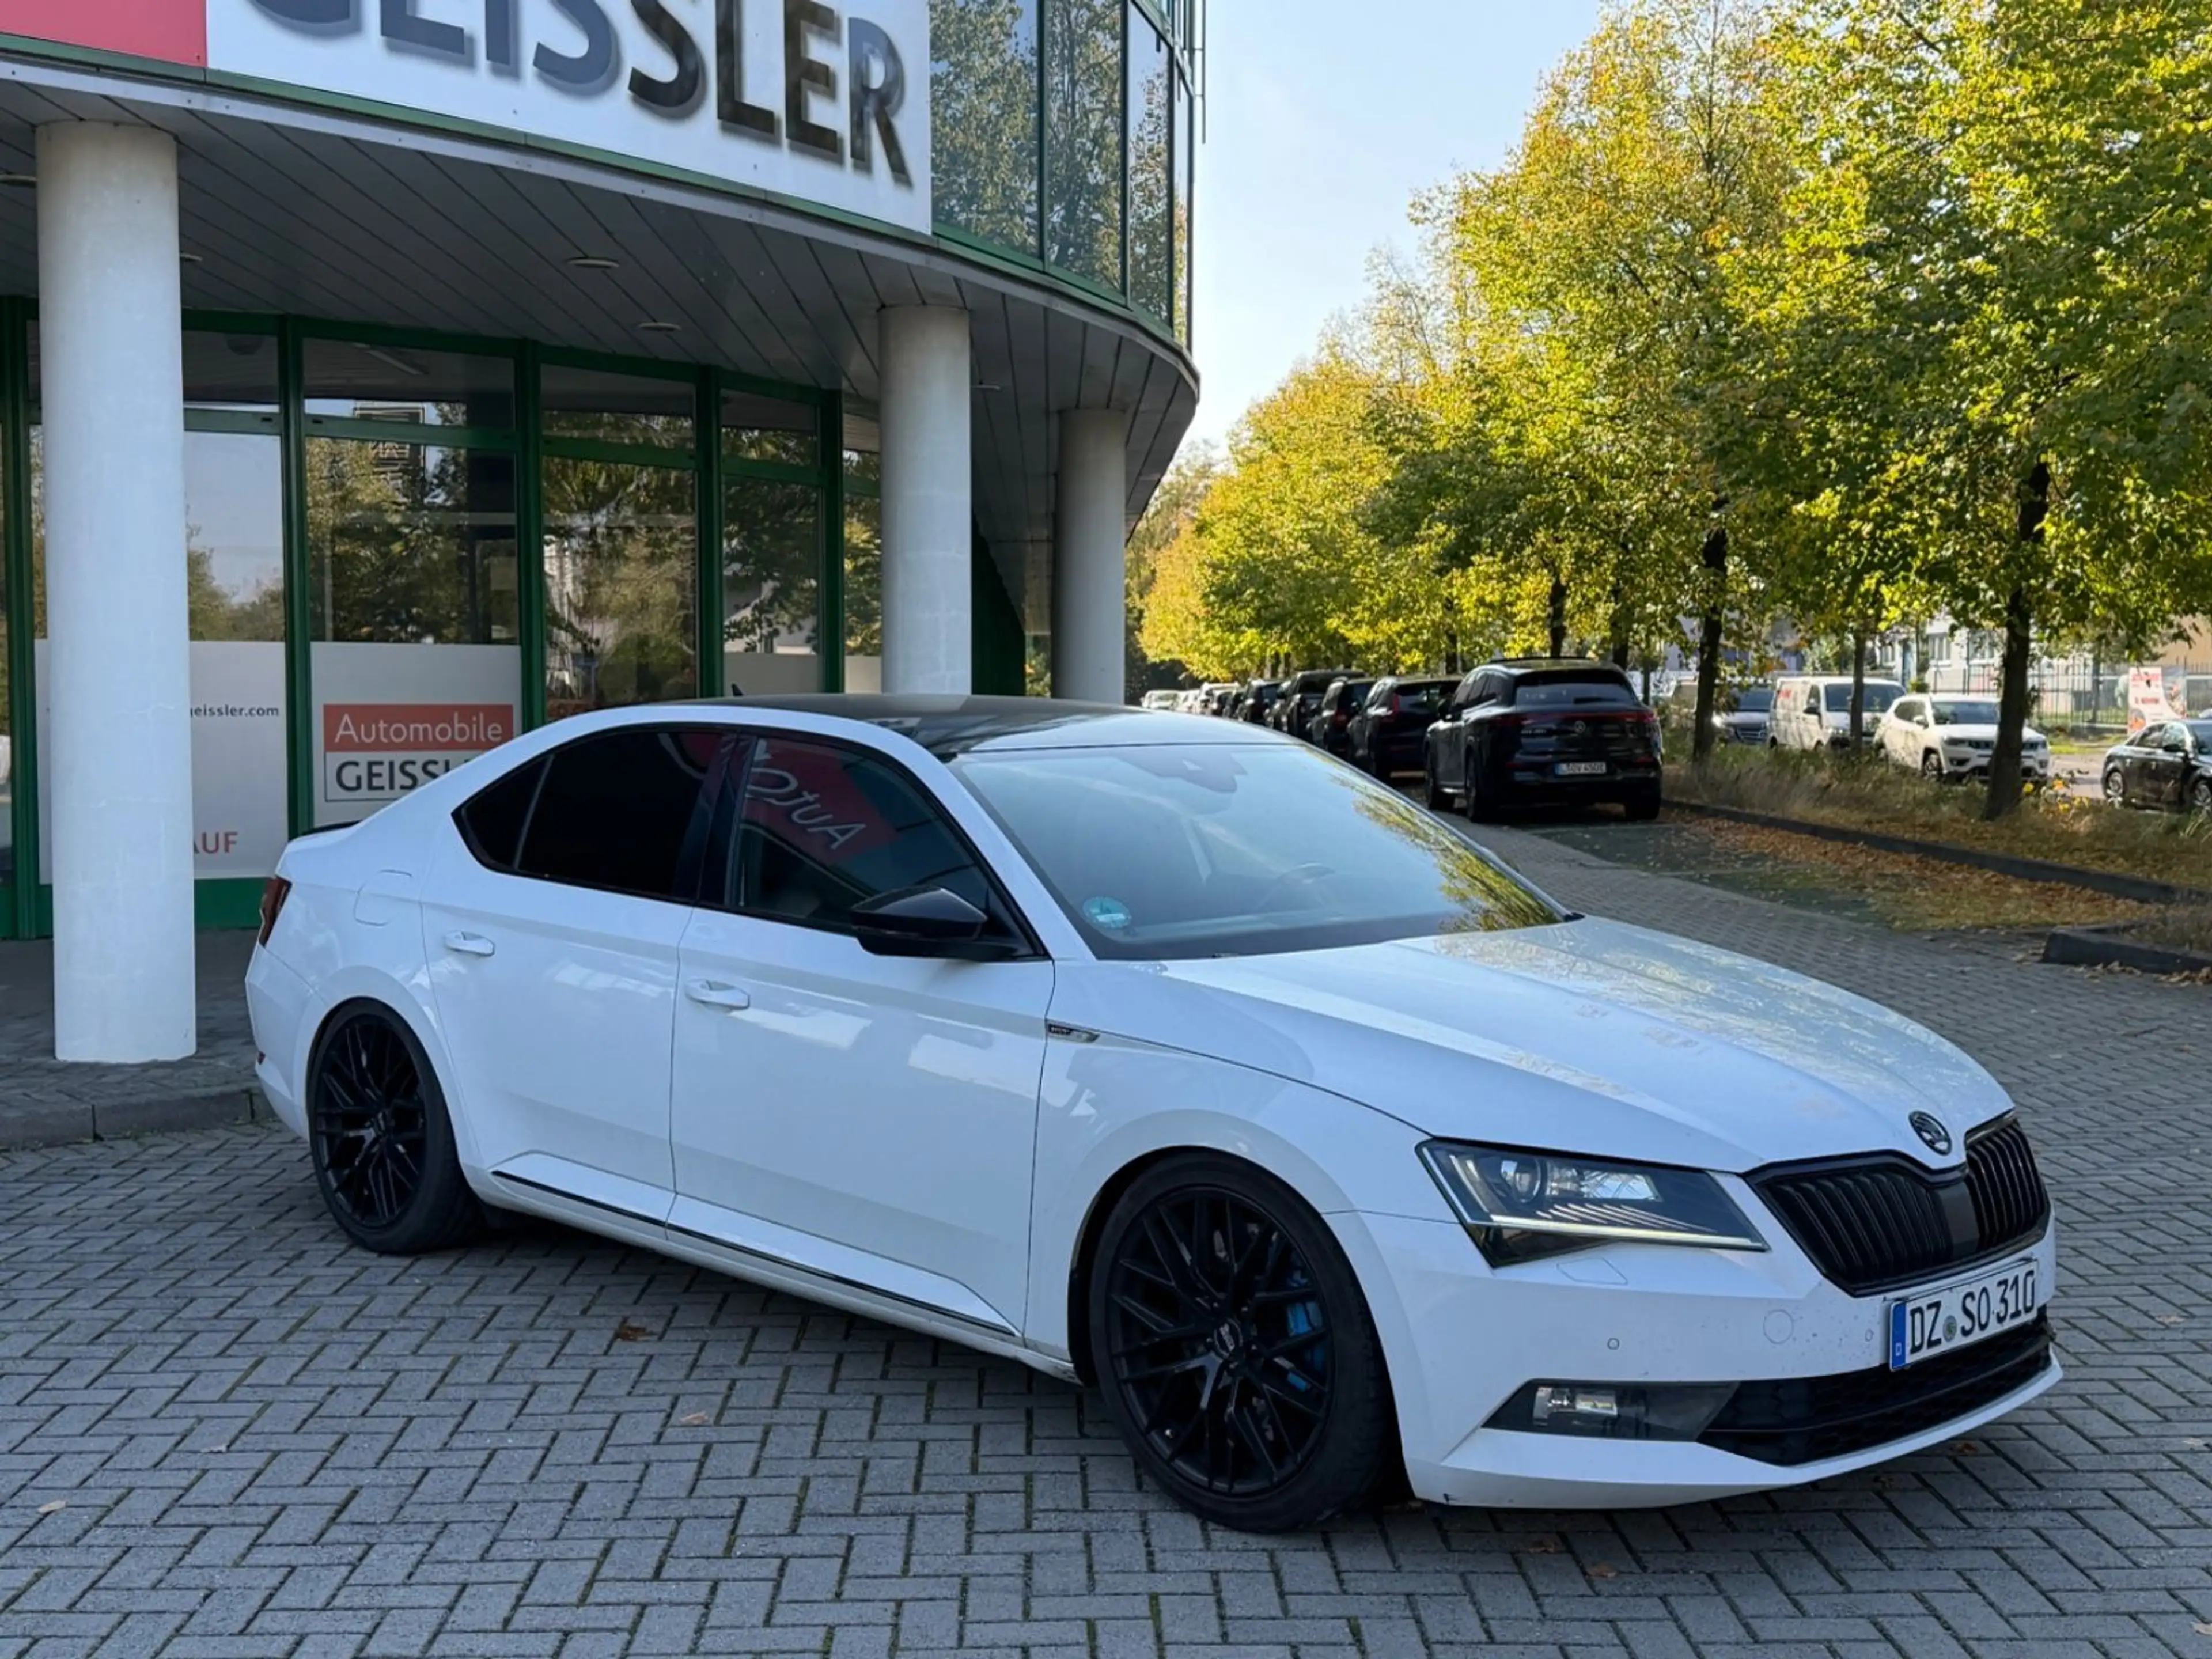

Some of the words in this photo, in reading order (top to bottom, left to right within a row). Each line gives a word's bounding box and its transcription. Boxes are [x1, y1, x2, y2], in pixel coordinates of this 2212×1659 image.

[247, 0, 912, 187] SSLER
[334, 712, 502, 743] Automobile
[335, 759, 471, 791] GEISS
[193, 831, 238, 854] UF
[1910, 1300, 1942, 1355] DZ
